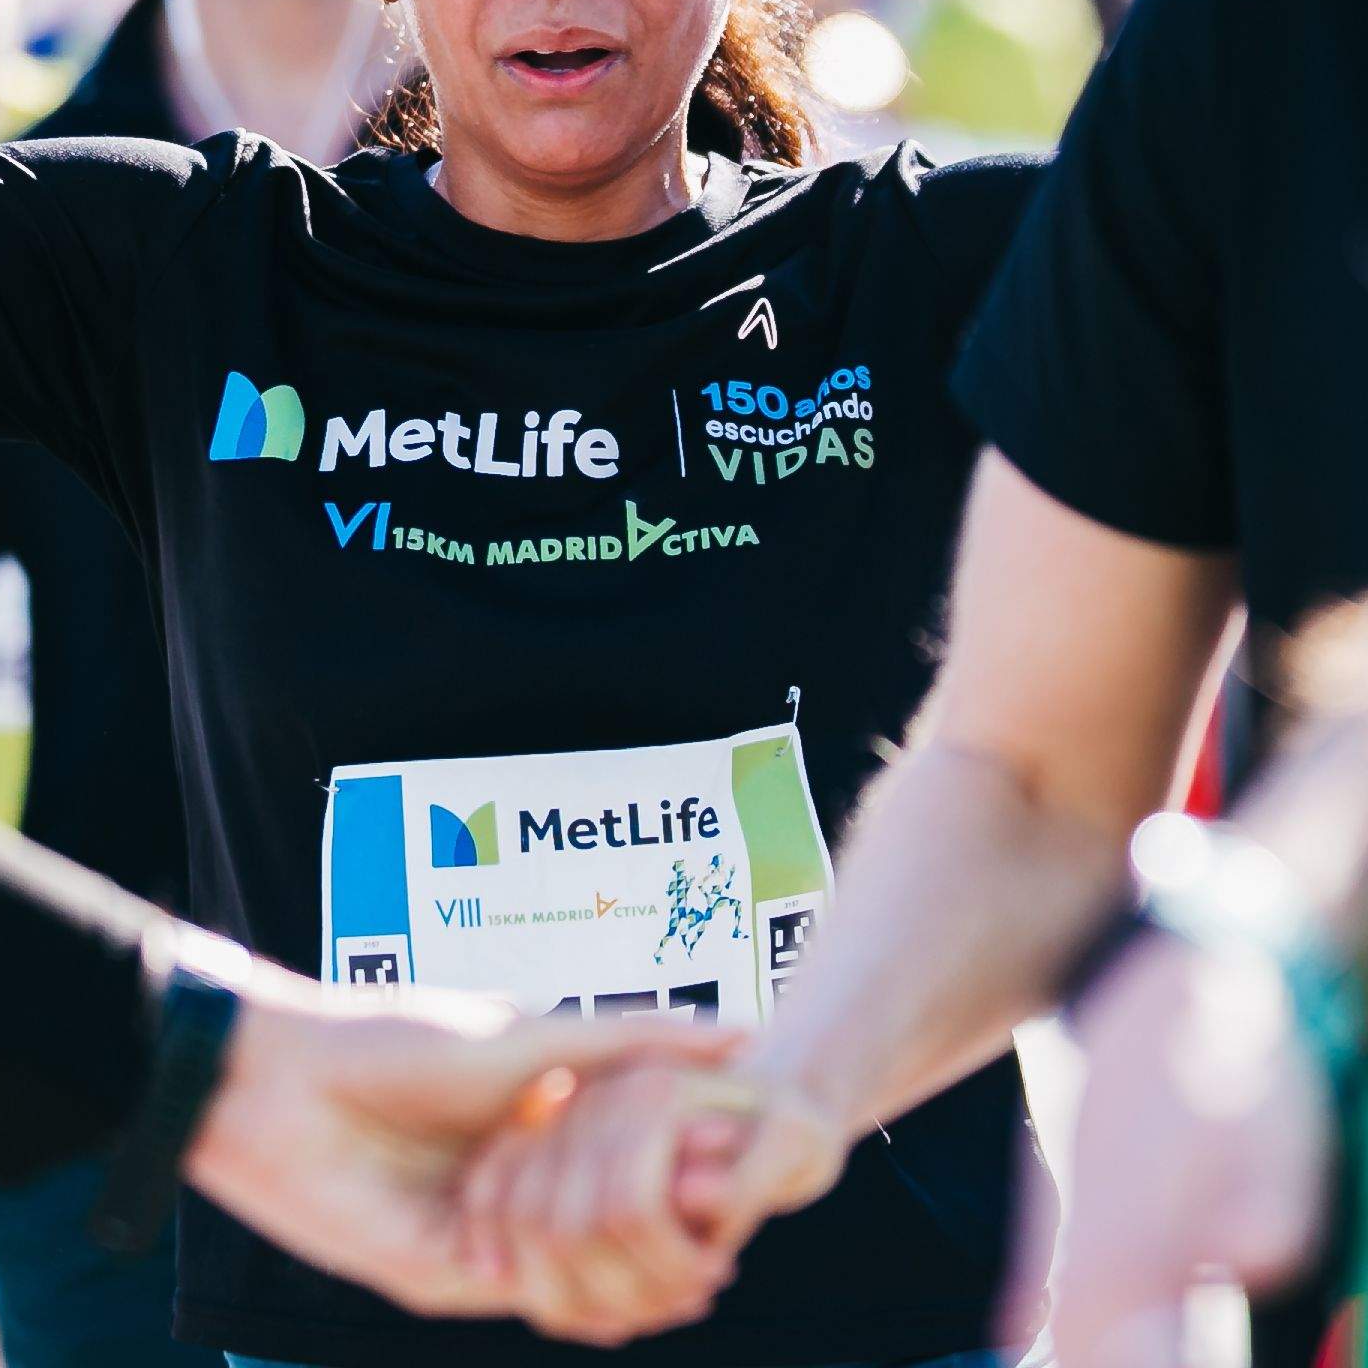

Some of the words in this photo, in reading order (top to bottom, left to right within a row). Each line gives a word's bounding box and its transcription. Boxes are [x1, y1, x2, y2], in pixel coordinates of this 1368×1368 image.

[701, 380, 789, 420] 150
[319, 408, 620, 480] MetLife
[708, 427, 875, 485] VIDAS
[519, 796, 721, 853] MetLife
[434, 897, 482, 928] VIII
[488, 912, 526, 927] 15KM
